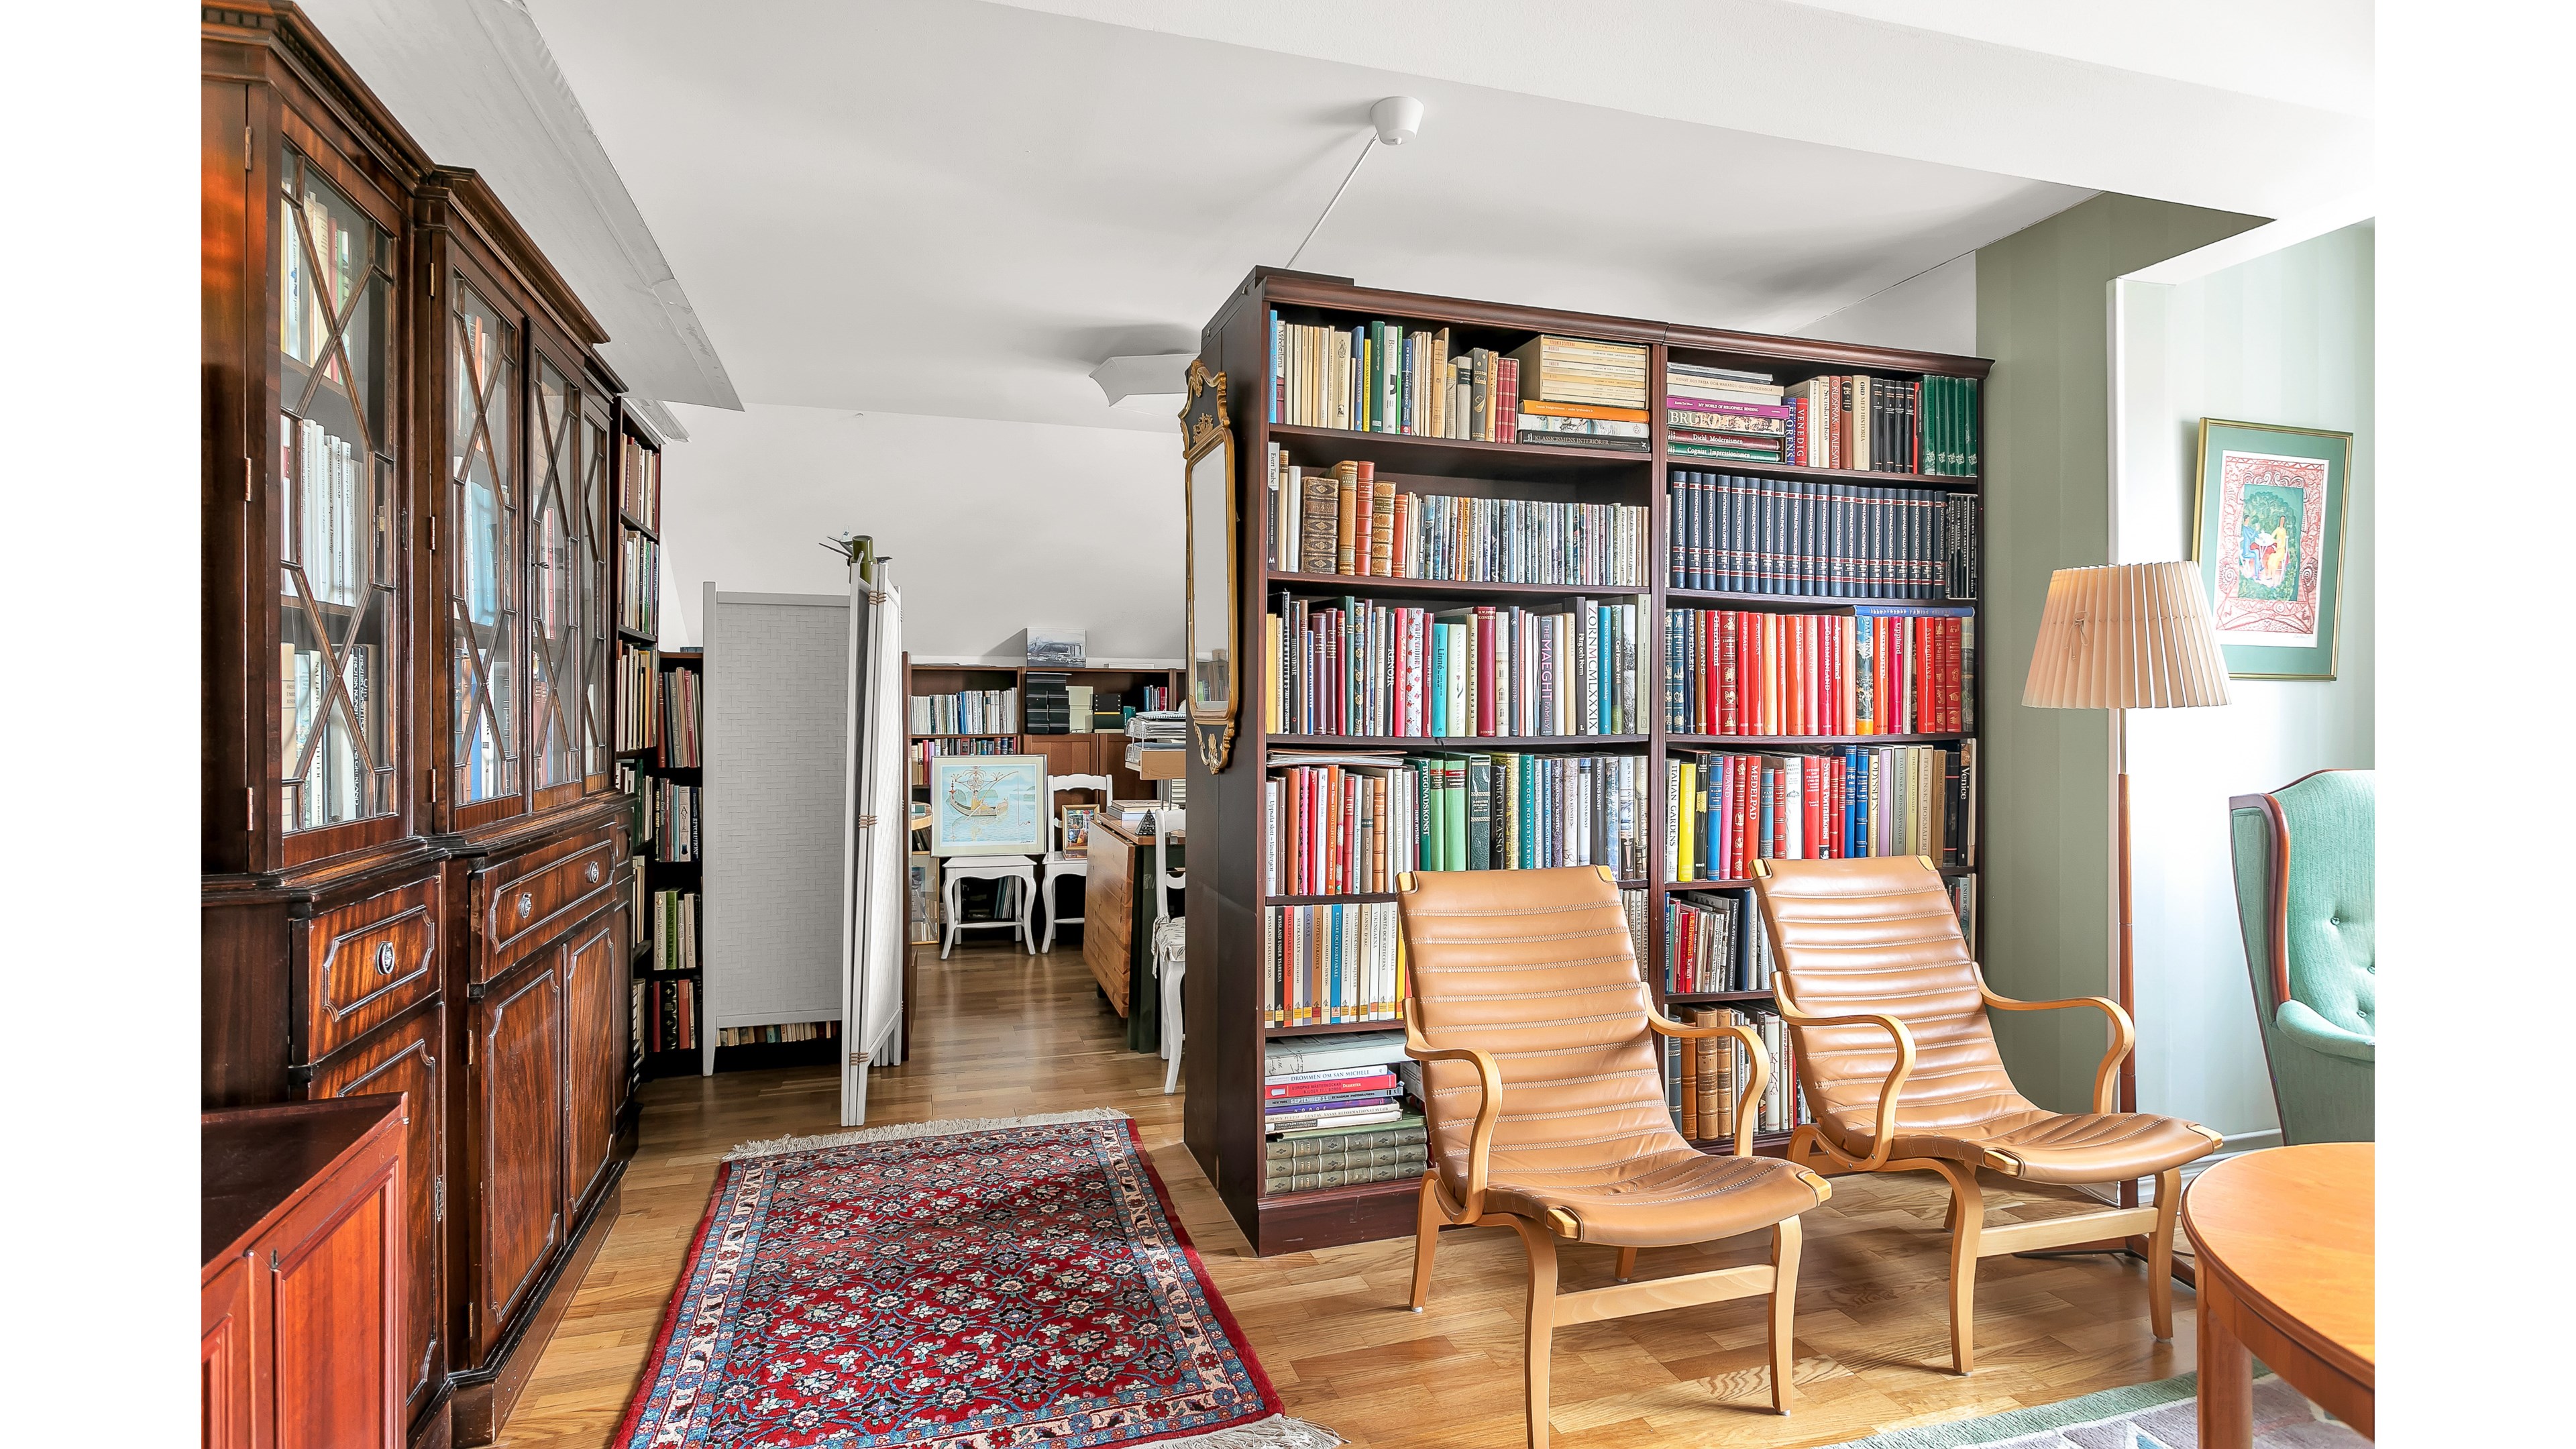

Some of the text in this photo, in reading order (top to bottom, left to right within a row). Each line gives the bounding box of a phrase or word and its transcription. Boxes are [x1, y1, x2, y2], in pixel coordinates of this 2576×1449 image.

[1387, 339, 1395, 370] Bevingat
[1576, 437, 1609, 445] INTERIÖRER
[1708, 447, 1751, 459] Impressionismen
[1709, 435, 1743, 445] Modernismen
[1387, 648, 1395, 687] RENOIR
[1542, 639, 1552, 701] MAEGHT
[1495, 772, 1503, 804] PABLO
[1750, 765, 1758, 820] MEDELPAD
[1960, 767, 1970, 800] Venice
[1291, 1073, 1322, 1081] DRÖMMEN
[1770, 1053, 1778, 1092] KINA
